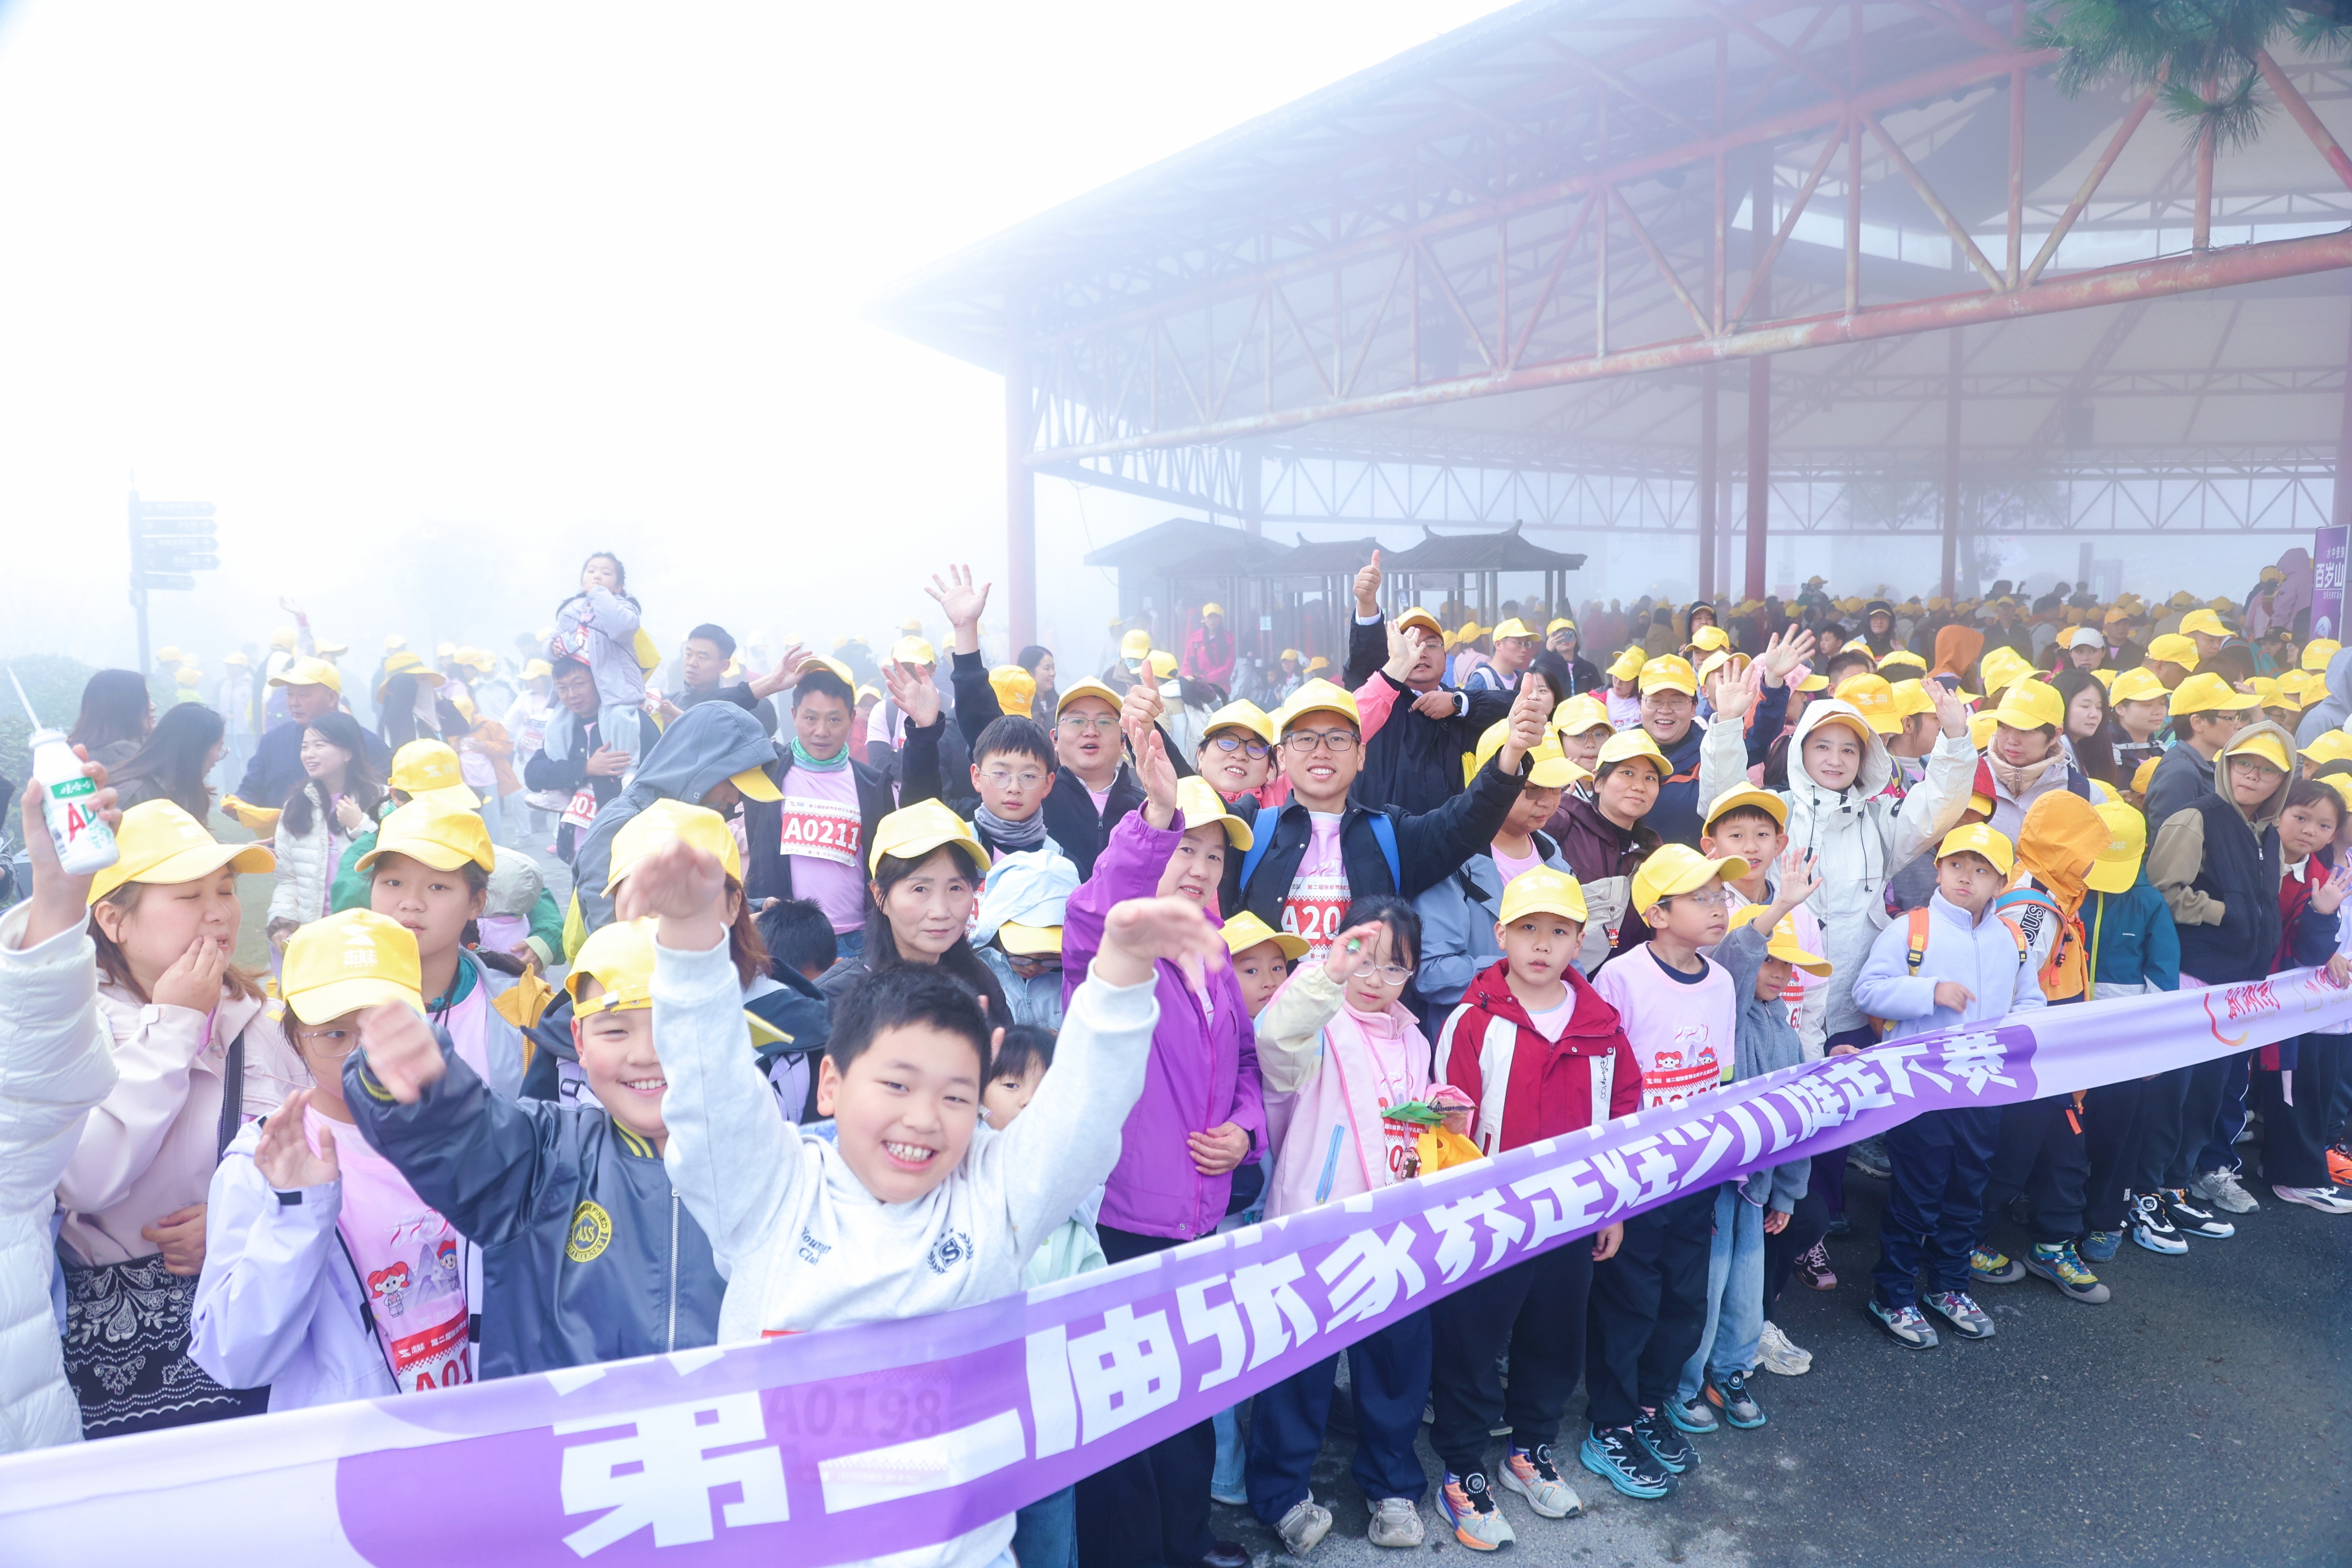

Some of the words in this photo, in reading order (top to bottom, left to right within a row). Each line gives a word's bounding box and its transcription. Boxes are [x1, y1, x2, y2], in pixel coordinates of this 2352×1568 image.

[2327, 546, 2345, 559] 水中贵族
[2315, 562, 2344, 588] 百岁山
[784, 818, 858, 851] A0211
[2021, 905, 2046, 949] OUS
[2237, 1015, 2257, 1025] Hunan
[2259, 1010, 2276, 1019] Today
